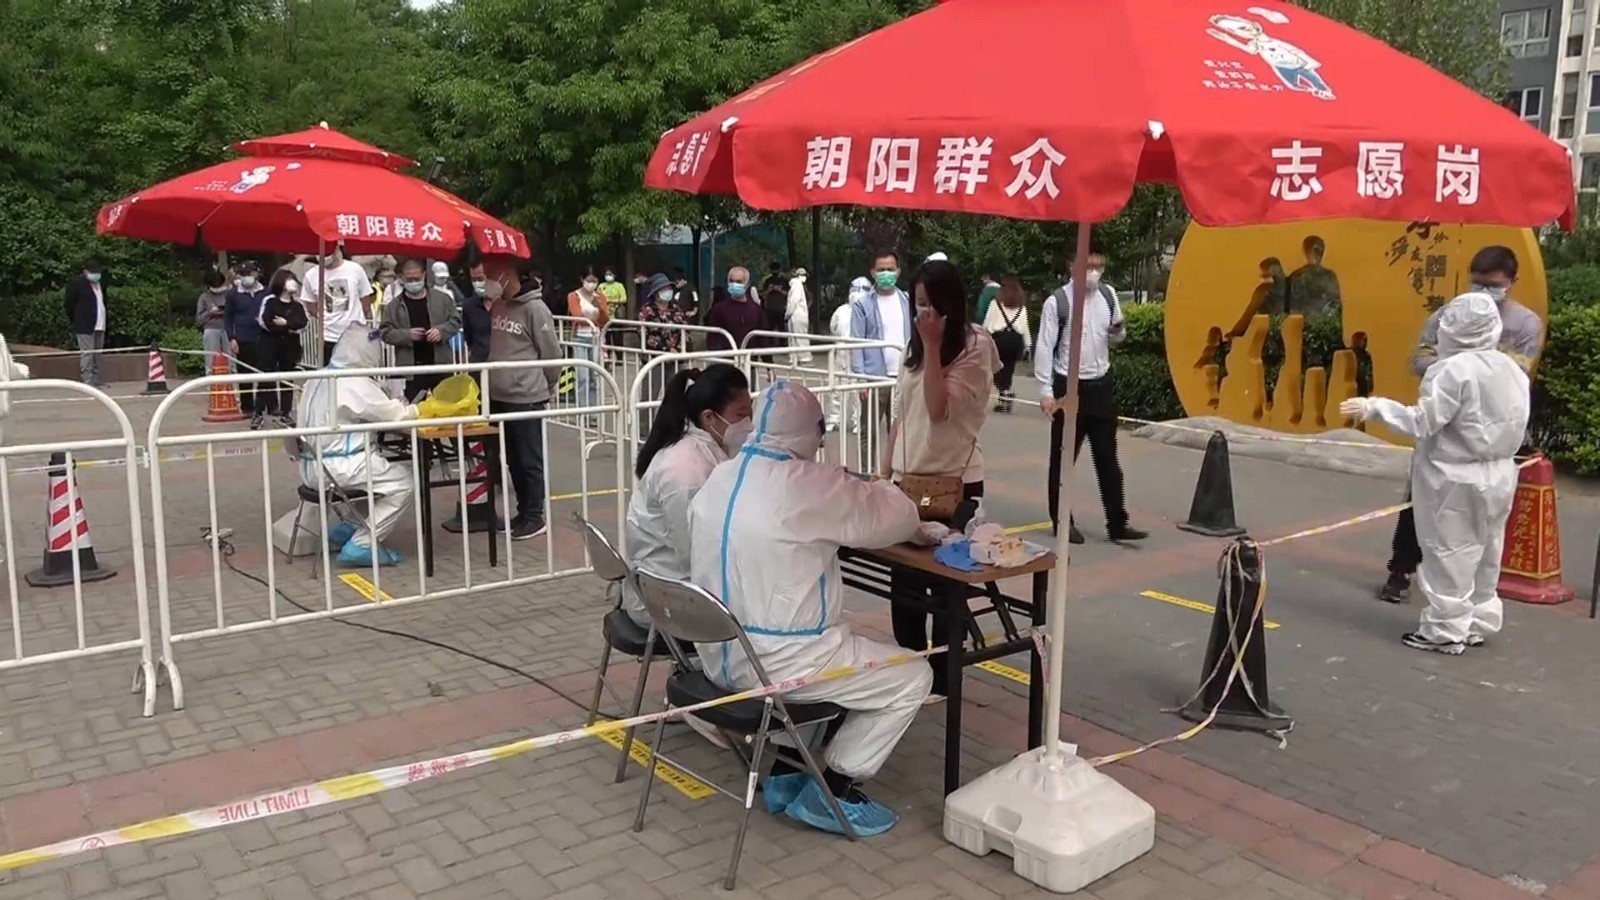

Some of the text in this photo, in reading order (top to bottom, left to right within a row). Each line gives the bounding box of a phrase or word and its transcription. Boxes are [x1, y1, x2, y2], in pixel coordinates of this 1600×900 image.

[802, 135, 1067, 200] 朝阳群众
[1270, 139, 1480, 205] 志愿岗
[336, 213, 443, 242] 朝阳群众
